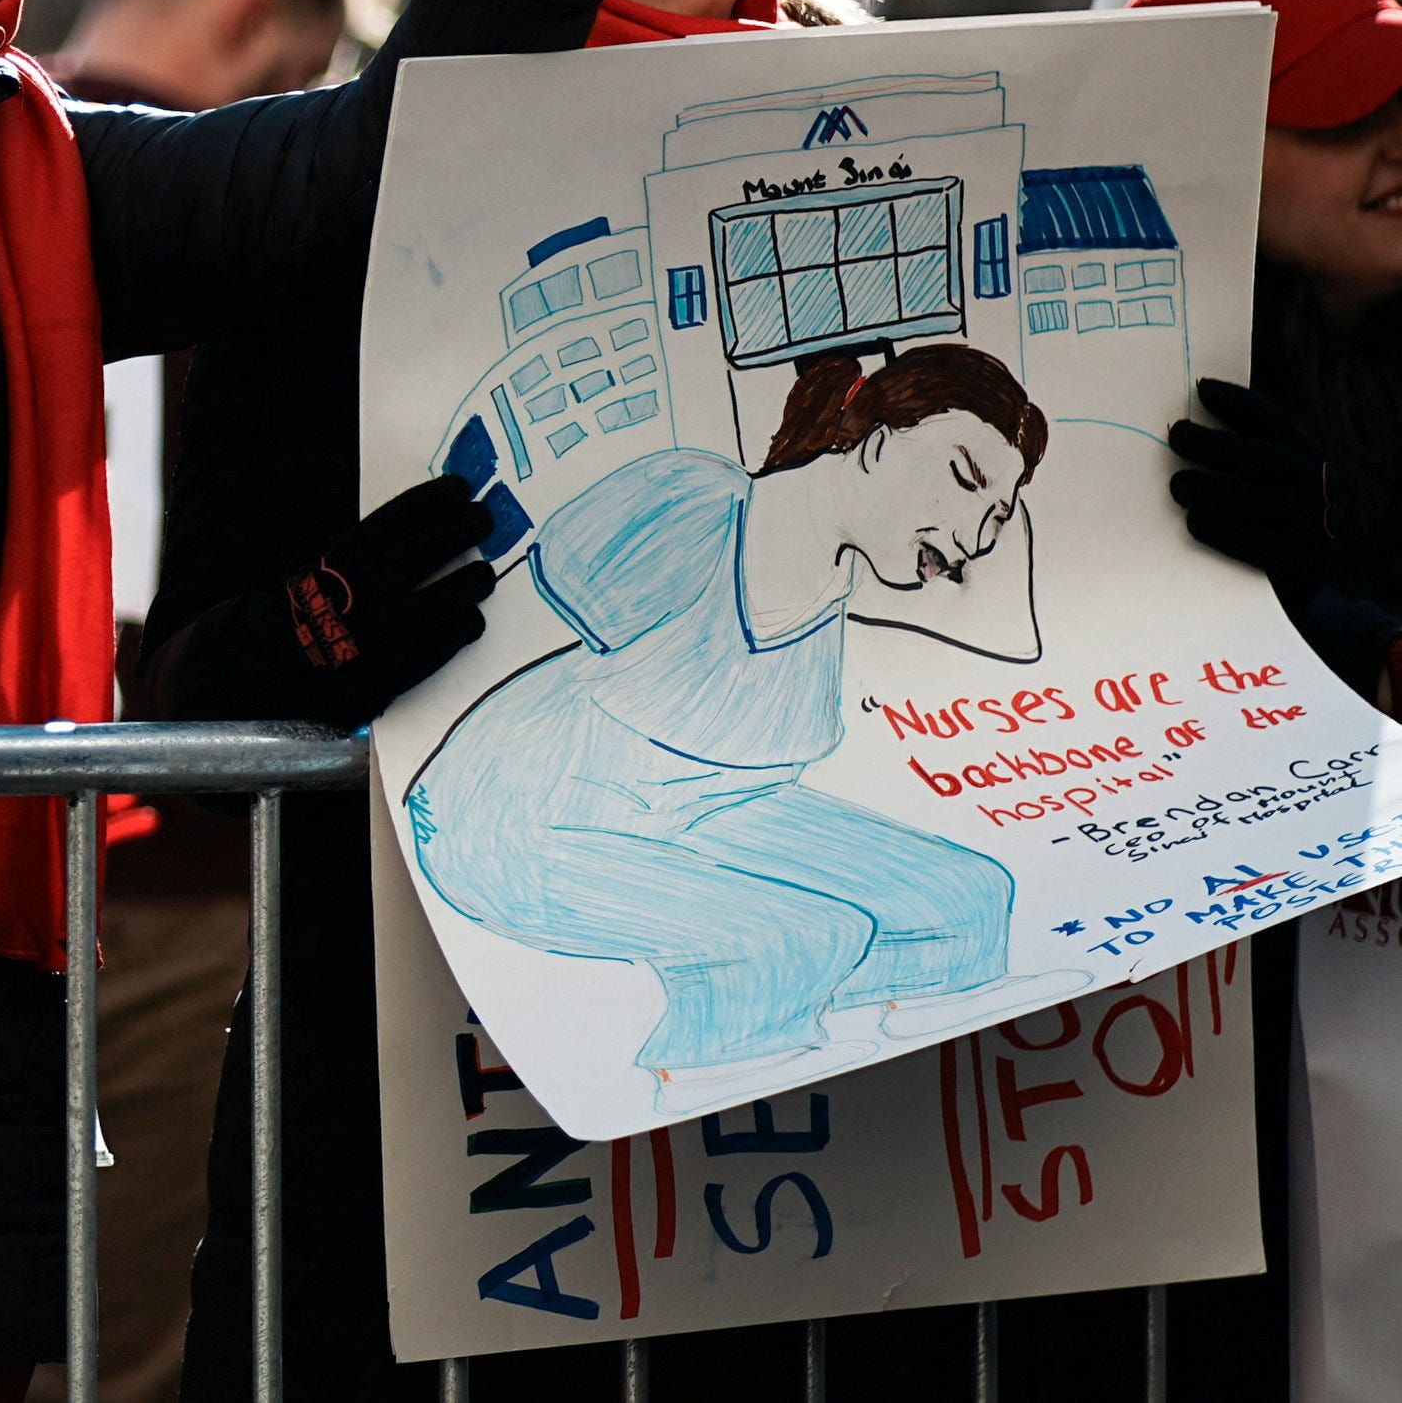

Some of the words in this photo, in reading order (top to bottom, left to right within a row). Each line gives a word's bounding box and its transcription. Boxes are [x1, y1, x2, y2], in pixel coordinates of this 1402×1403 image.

[742, 169, 827, 203] Mount
[838, 153, 913, 186] Sinai
[1094, 670, 1184, 714] are
[1198, 659, 1288, 695] the
[908, 734, 1143, 798] backbone
[1164, 719, 1208, 749] of
[1241, 703, 1308, 730] the
[1288, 744, 1379, 780] Carr
[1192, 810, 1231, 829] of
[1086, 929, 1156, 957] TO
[1186, 871, 1317, 925] MAKE
[1105, 898, 1174, 929] NO
[455, 1006, 600, 1321] ANT
